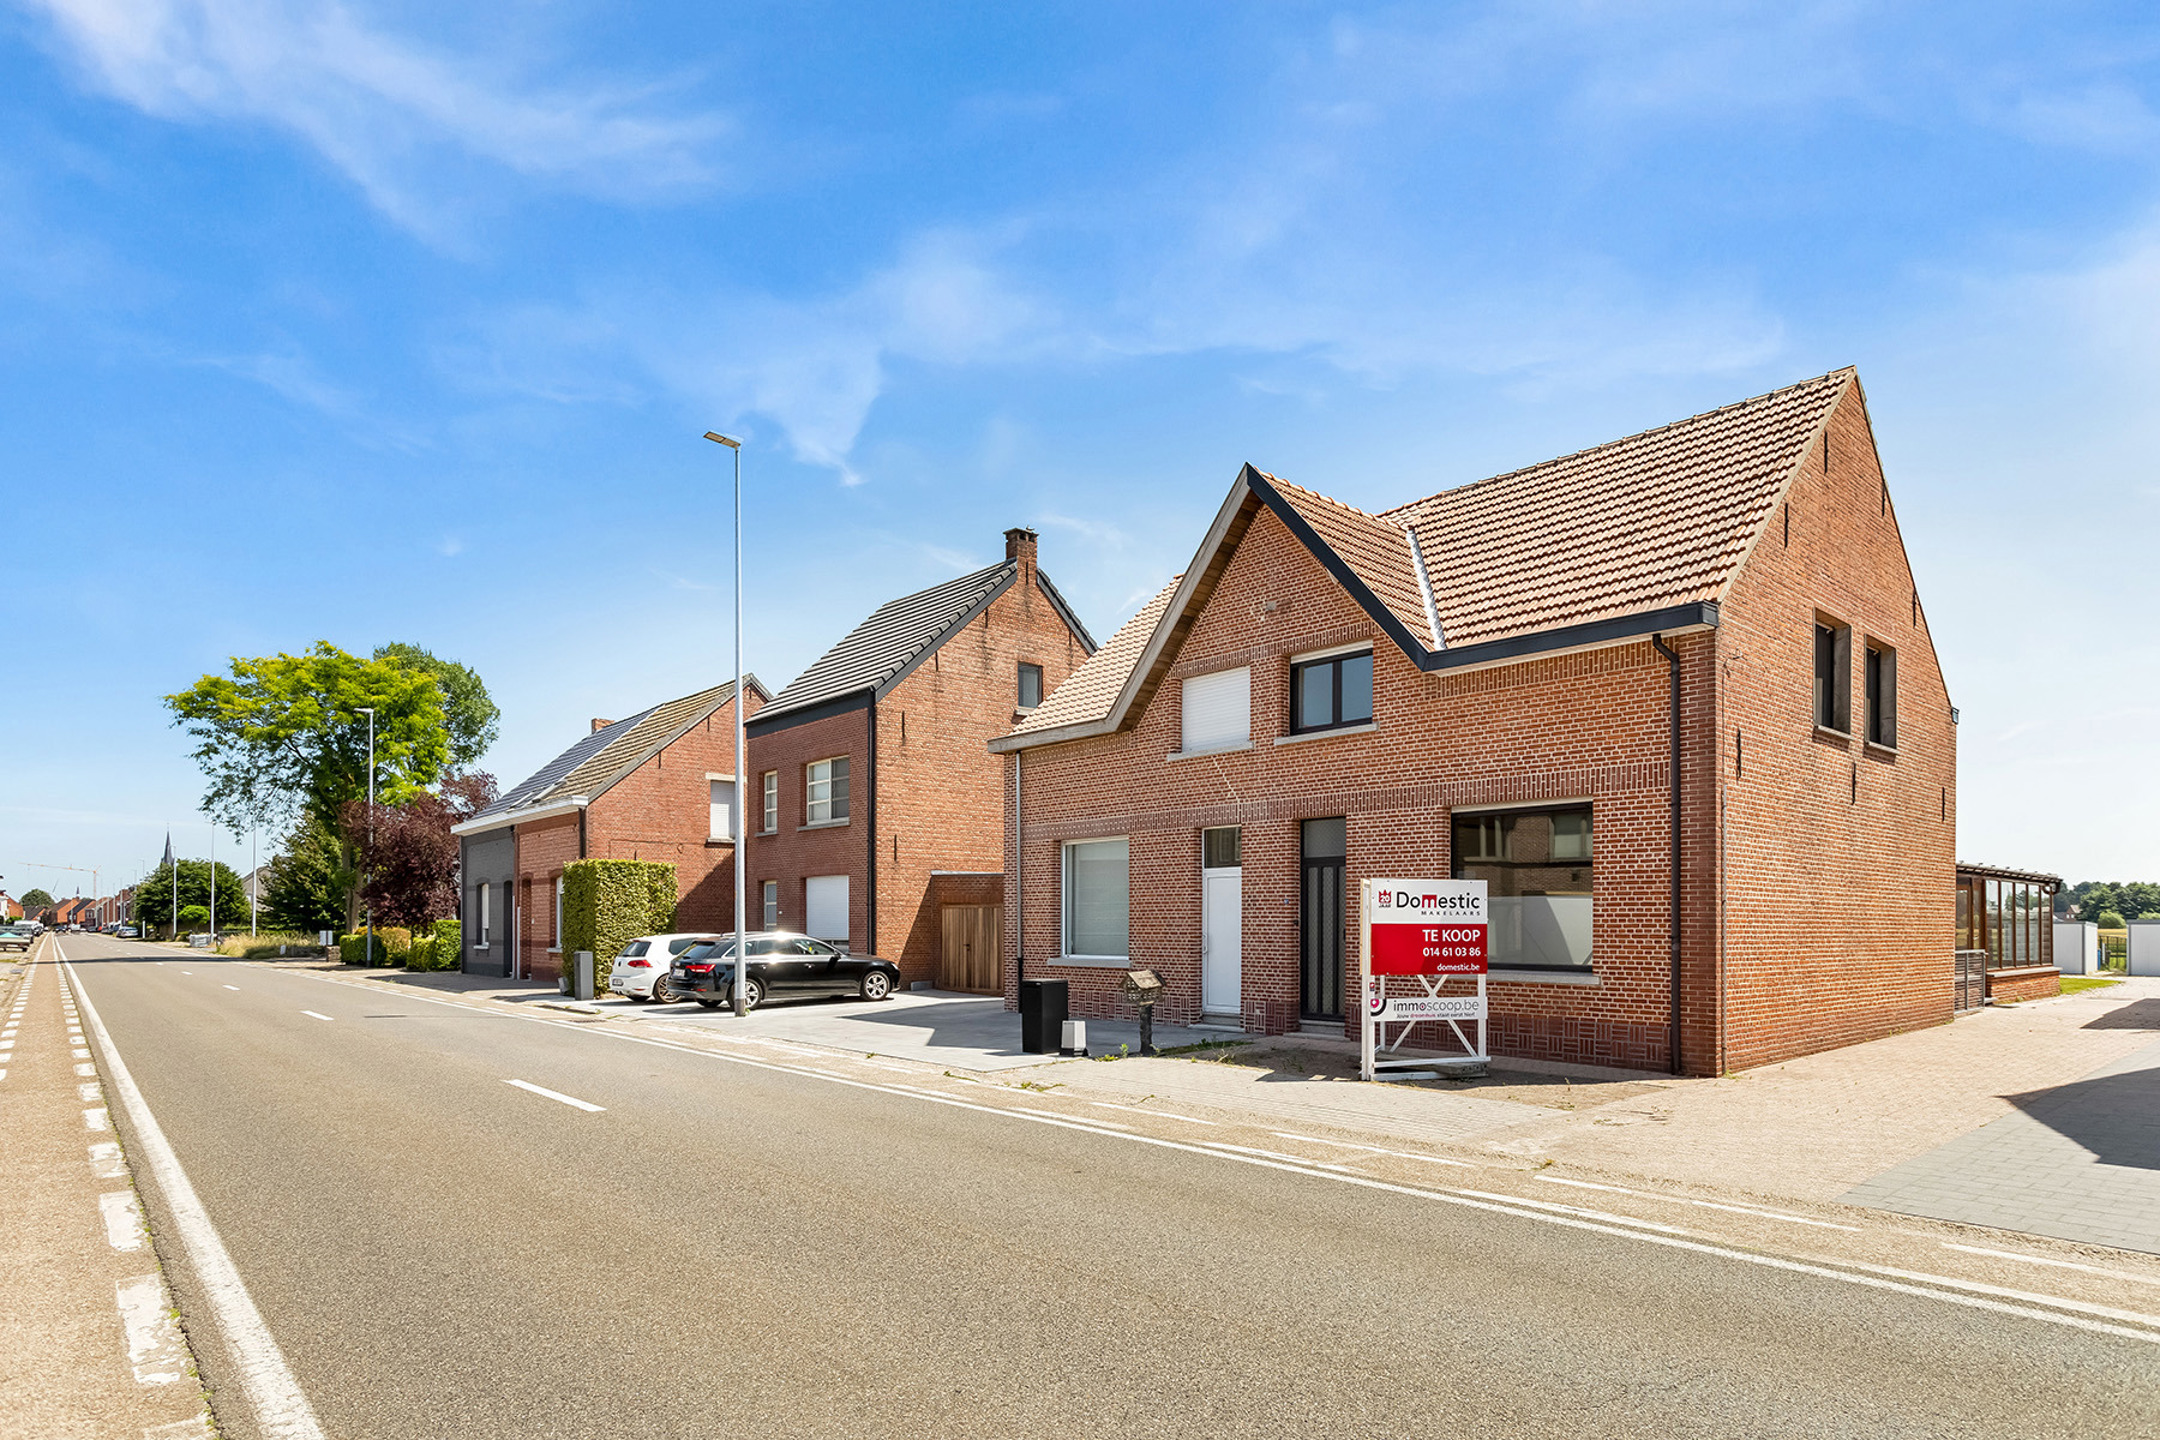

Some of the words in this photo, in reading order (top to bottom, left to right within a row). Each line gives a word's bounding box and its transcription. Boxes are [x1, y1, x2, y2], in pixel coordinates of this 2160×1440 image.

[1396, 891, 1480, 909] Domestic
[1422, 929, 1439, 942] TE
[1442, 929, 1481, 942] KOOP
[1422, 947, 1440, 957] 014
[1442, 947, 1453, 957] 61
[1455, 947, 1467, 957] 03
[1469, 947, 1481, 957] 86
[1437, 963, 1480, 971] domestic.be
[1393, 999, 1480, 1012] immoscoop.be
